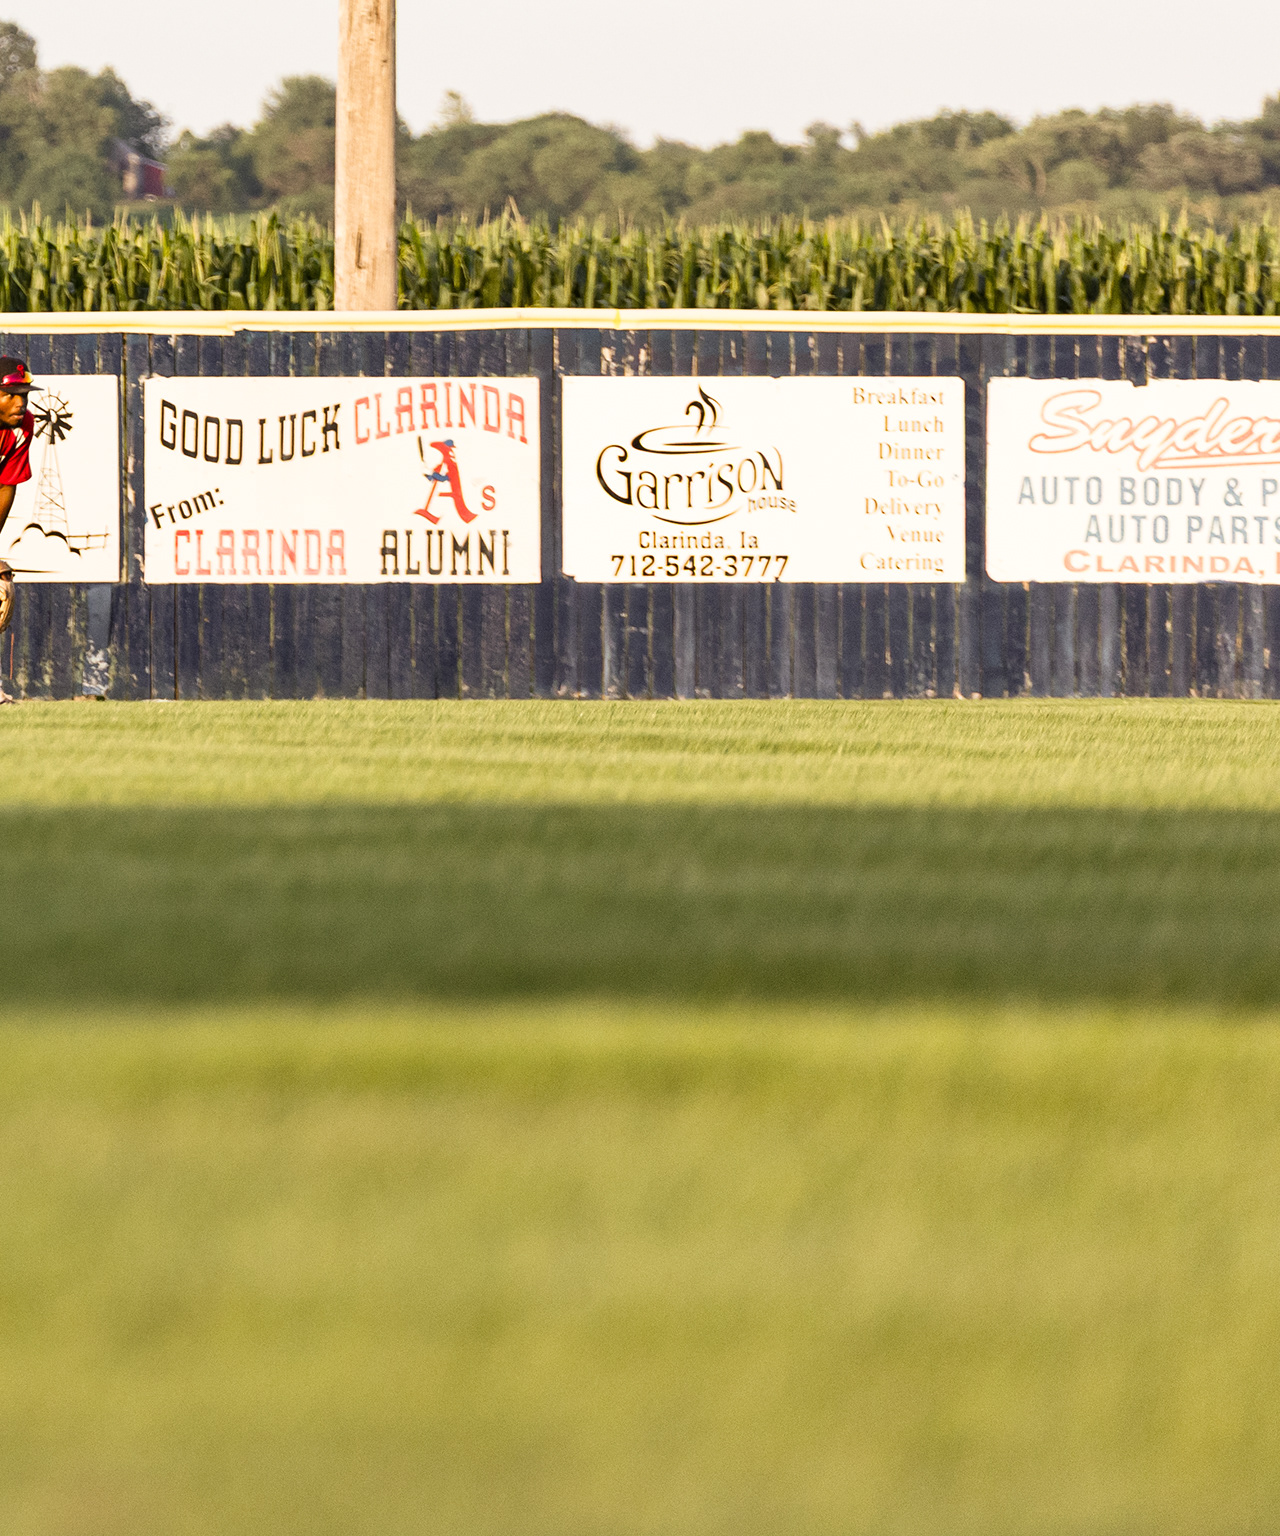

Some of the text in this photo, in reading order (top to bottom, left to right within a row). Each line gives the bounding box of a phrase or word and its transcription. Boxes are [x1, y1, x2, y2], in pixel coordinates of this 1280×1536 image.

[852, 386, 944, 405] Breakfast
[160, 382, 528, 465] GOOD LUCK CLARINDA
[883, 415, 944, 433] Lunch
[878, 442, 944, 460] Dinner
[885, 470, 944, 488] To-Go
[1018, 476, 1102, 505] AUTO
[1119, 477, 1205, 506] BODY
[1223, 477, 1243, 507] &
[148, 486, 225, 529] From:
[747, 496, 797, 513] house
[864, 497, 944, 520] Delivery
[740, 531, 759, 549] Ia
[884, 524, 944, 543] Venue
[1085, 515, 1169, 543] AUTO
[173, 529, 510, 576] CLARINDA ALUMNI
[859, 552, 944, 575] Catering
[1063, 549, 1266, 578] CLARINDA,
[611, 554, 788, 577] 712-542-3777
